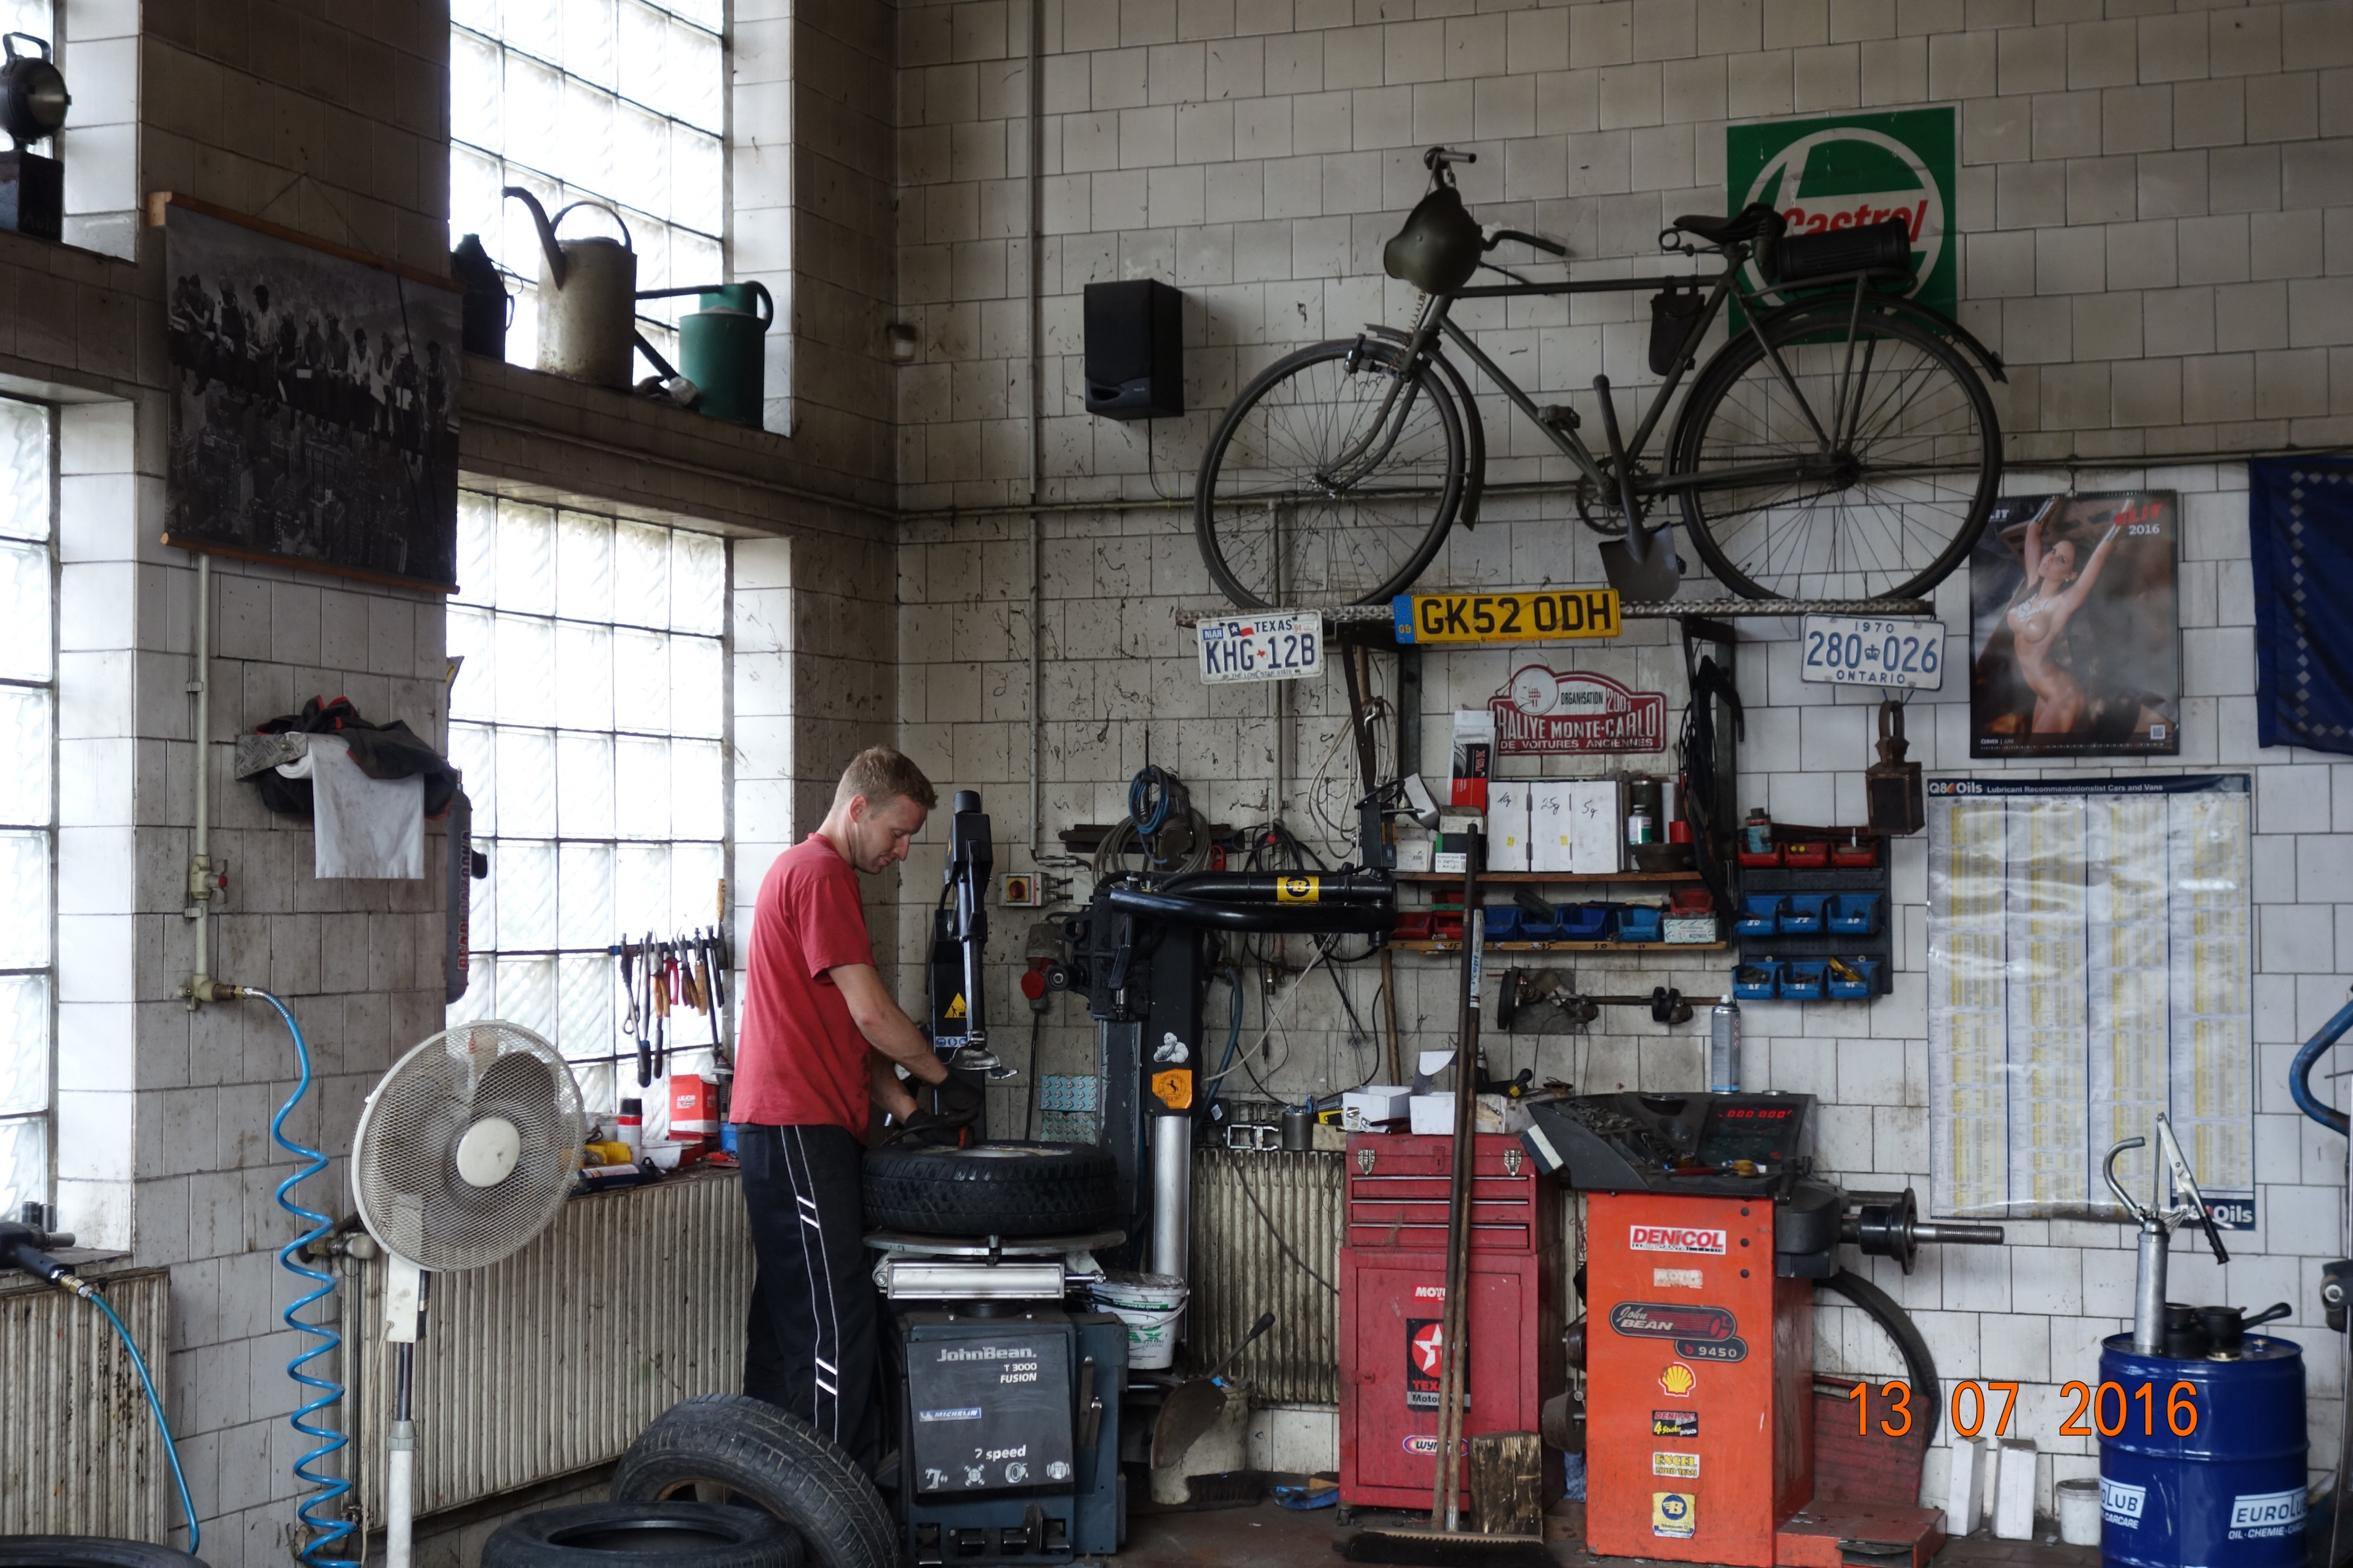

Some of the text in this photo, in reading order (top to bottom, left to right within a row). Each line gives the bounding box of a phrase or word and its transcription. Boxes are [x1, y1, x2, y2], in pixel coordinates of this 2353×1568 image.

[2115, 504, 2162, 526] ELIT
[2129, 524, 2160, 535] 2016
[1421, 597, 1522, 635] GK52
[1254, 619, 1293, 633] TEXAS
[1398, 623, 1412, 635] GB
[1855, 621, 1894, 633] 1970
[1204, 630, 1222, 639] MAR
[1206, 633, 1315, 675] KHG 12B
[1807, 630, 1938, 673] 280 026
[1836, 669, 1905, 685] ONTARIO
[1561, 691, 1604, 705] ORGANISATION
[1497, 704, 1547, 740] RALLYE
[1500, 738, 1654, 749] DE VOITURES ANCIENNES
[1955, 782, 1983, 793] Oils
[1987, 785, 2023, 793] Lubricant
[2024, 784, 2107, 793] Recommandationslist
[2213, 1205, 2253, 1223] Oils
[1415, 1286, 1446, 1297] MOT
[1616, 1306, 1648, 1323] John
[1620, 1319, 1674, 1330] BEAN
[1142, 1337, 1165, 1350] plus
[1698, 1346, 1738, 1358] 9450
[1004, 1362, 1038, 1372] T 3000
[1000, 1372, 1037, 1384] FUSION
[934, 1409, 978, 1418] MICHELIN
[1654, 1420, 1662, 1435] 4
[985, 1444, 1027, 1463] speed
[1655, 1454, 1698, 1467] EXCEL
[2101, 1484, 2138, 1512] OLUB
[2105, 1512, 2140, 1530] CARCARE
[2228, 1529, 2244, 1540] OIL
[2247, 1526, 2285, 1539] CHEMIE
